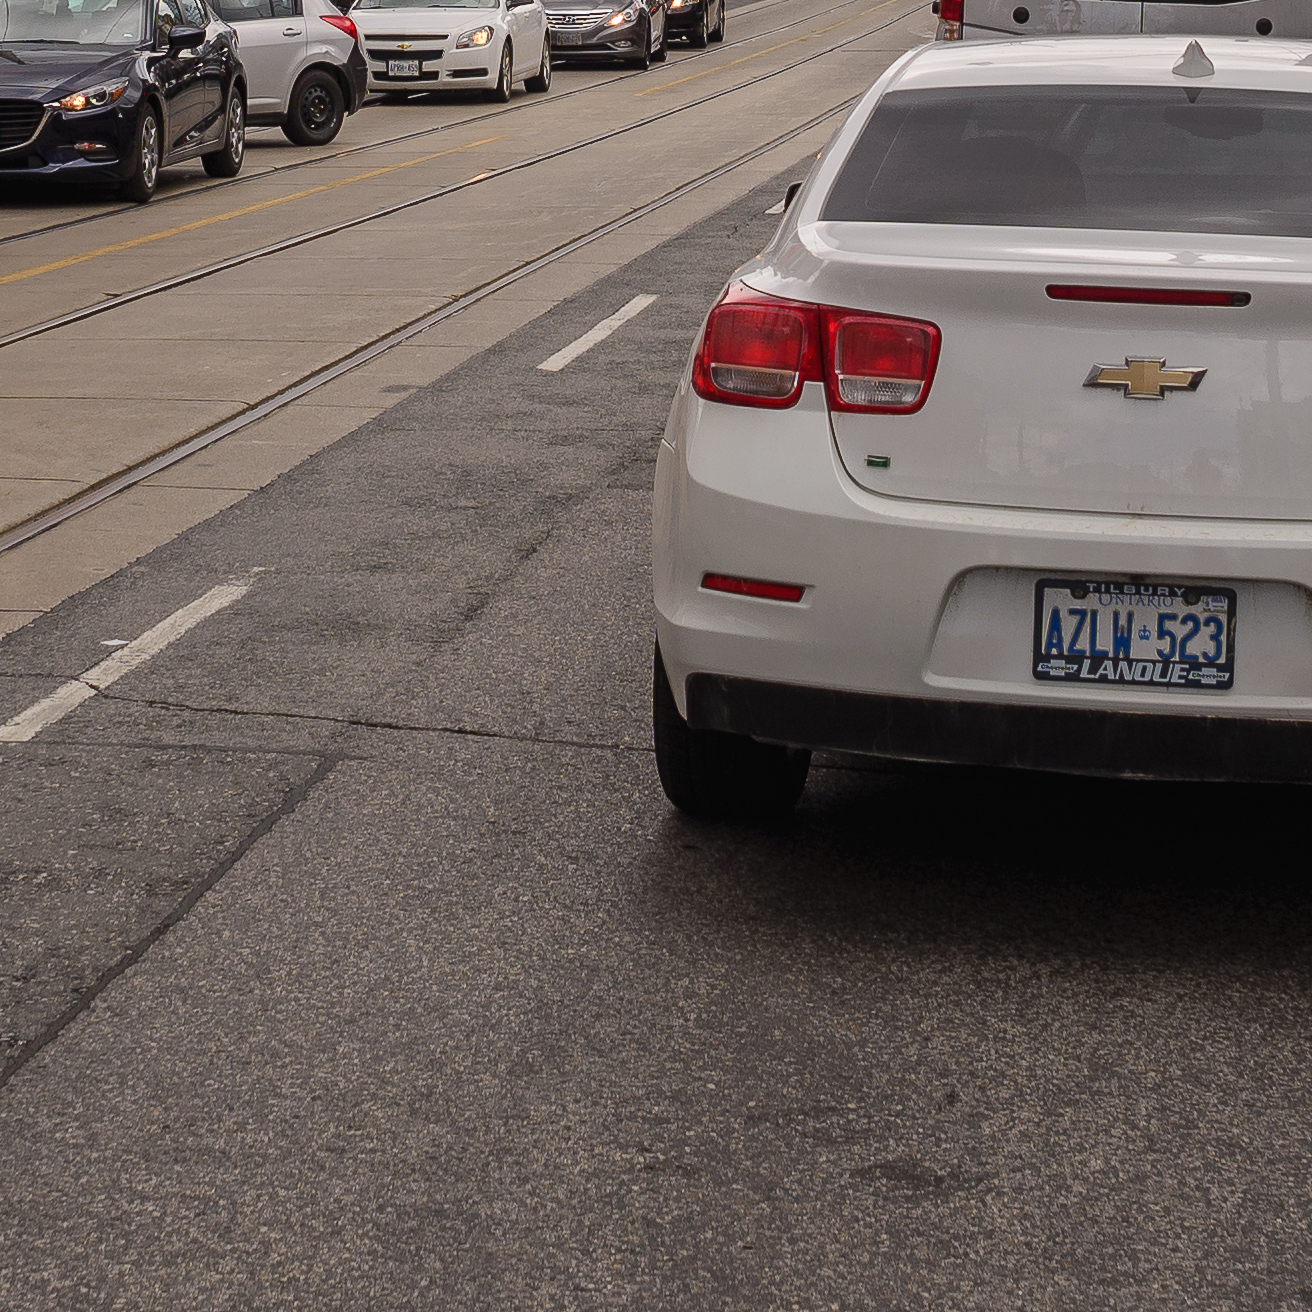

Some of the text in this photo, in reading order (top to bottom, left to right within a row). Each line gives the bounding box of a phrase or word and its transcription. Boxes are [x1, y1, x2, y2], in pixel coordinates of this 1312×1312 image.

[1087, 582, 1186, 597] TILBURY
[1098, 592, 1176, 609] ONTARIO
[1043, 604, 1226, 664] AZLW 523
[1079, 658, 1190, 685] LANOUE
